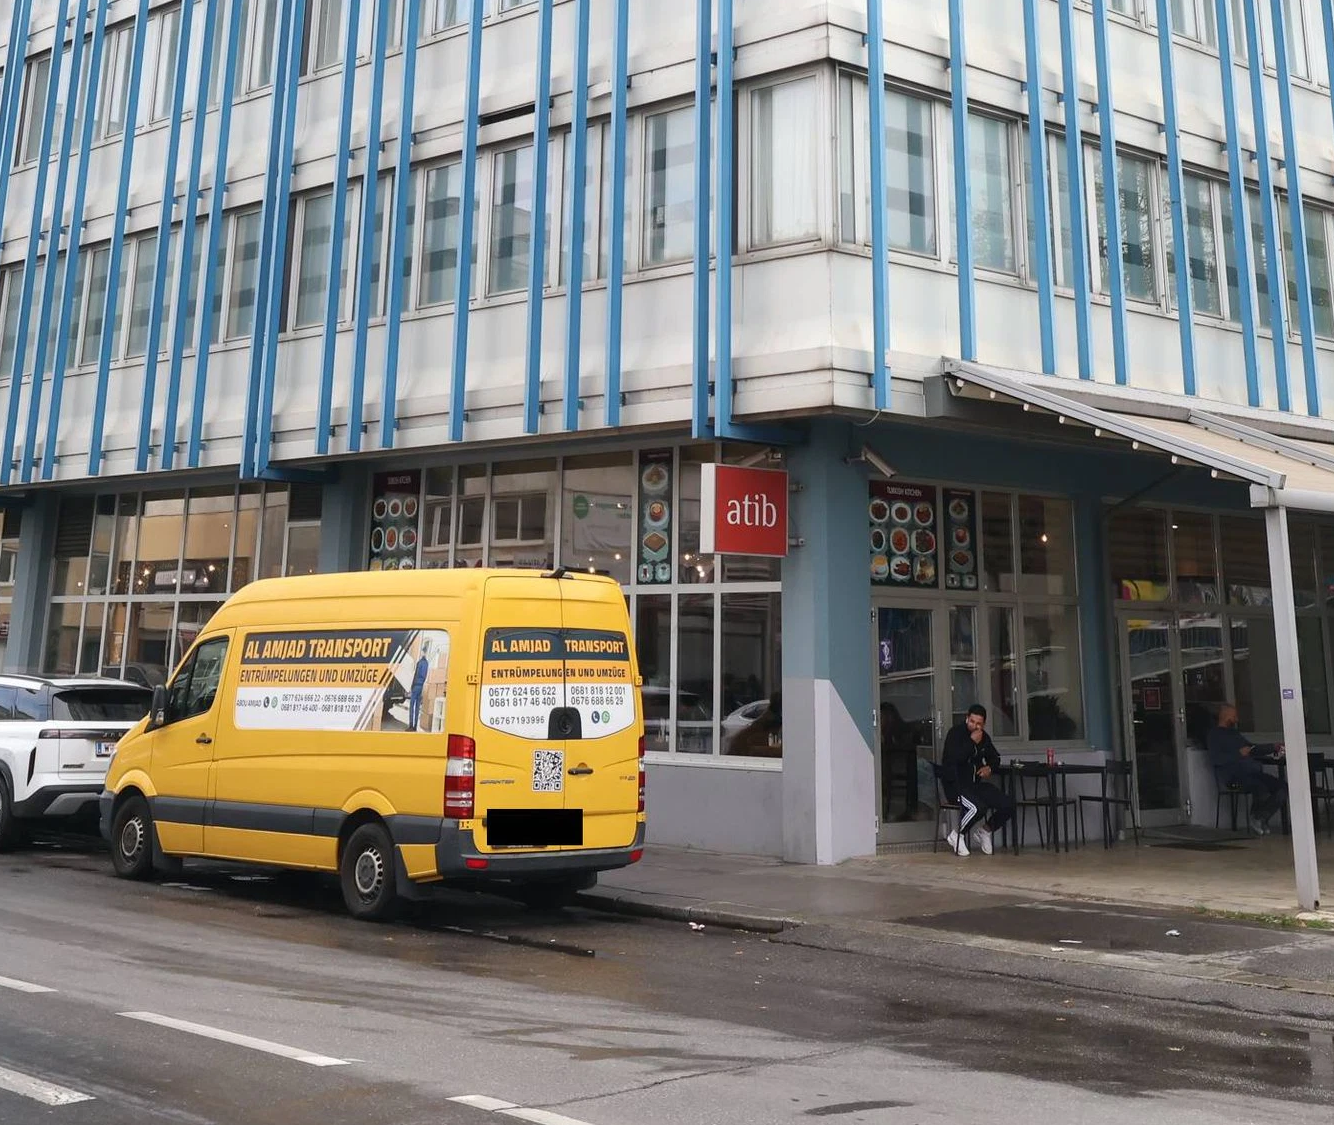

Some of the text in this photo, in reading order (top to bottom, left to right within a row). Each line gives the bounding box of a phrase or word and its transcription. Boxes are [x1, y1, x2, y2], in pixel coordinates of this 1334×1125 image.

[727, 493, 777, 528] atib
[245, 637, 392, 660] AL AMJAD TRANSPORT
[492, 639, 624, 653] AL AMJAD TRANSPORT
[240, 665, 378, 683] ENTRÜMPELUNGEN UND UMZÜGE
[579, 668, 595, 677] UND
[597, 666, 626, 678] UMZÜGE
[489, 686, 556, 696] 0677 624 66 622
[571, 686, 626, 695] 0681 818 12 001
[489, 697, 556, 707] 0681 817 46 400
[571, 697, 623, 706] 0676 688 66 29
